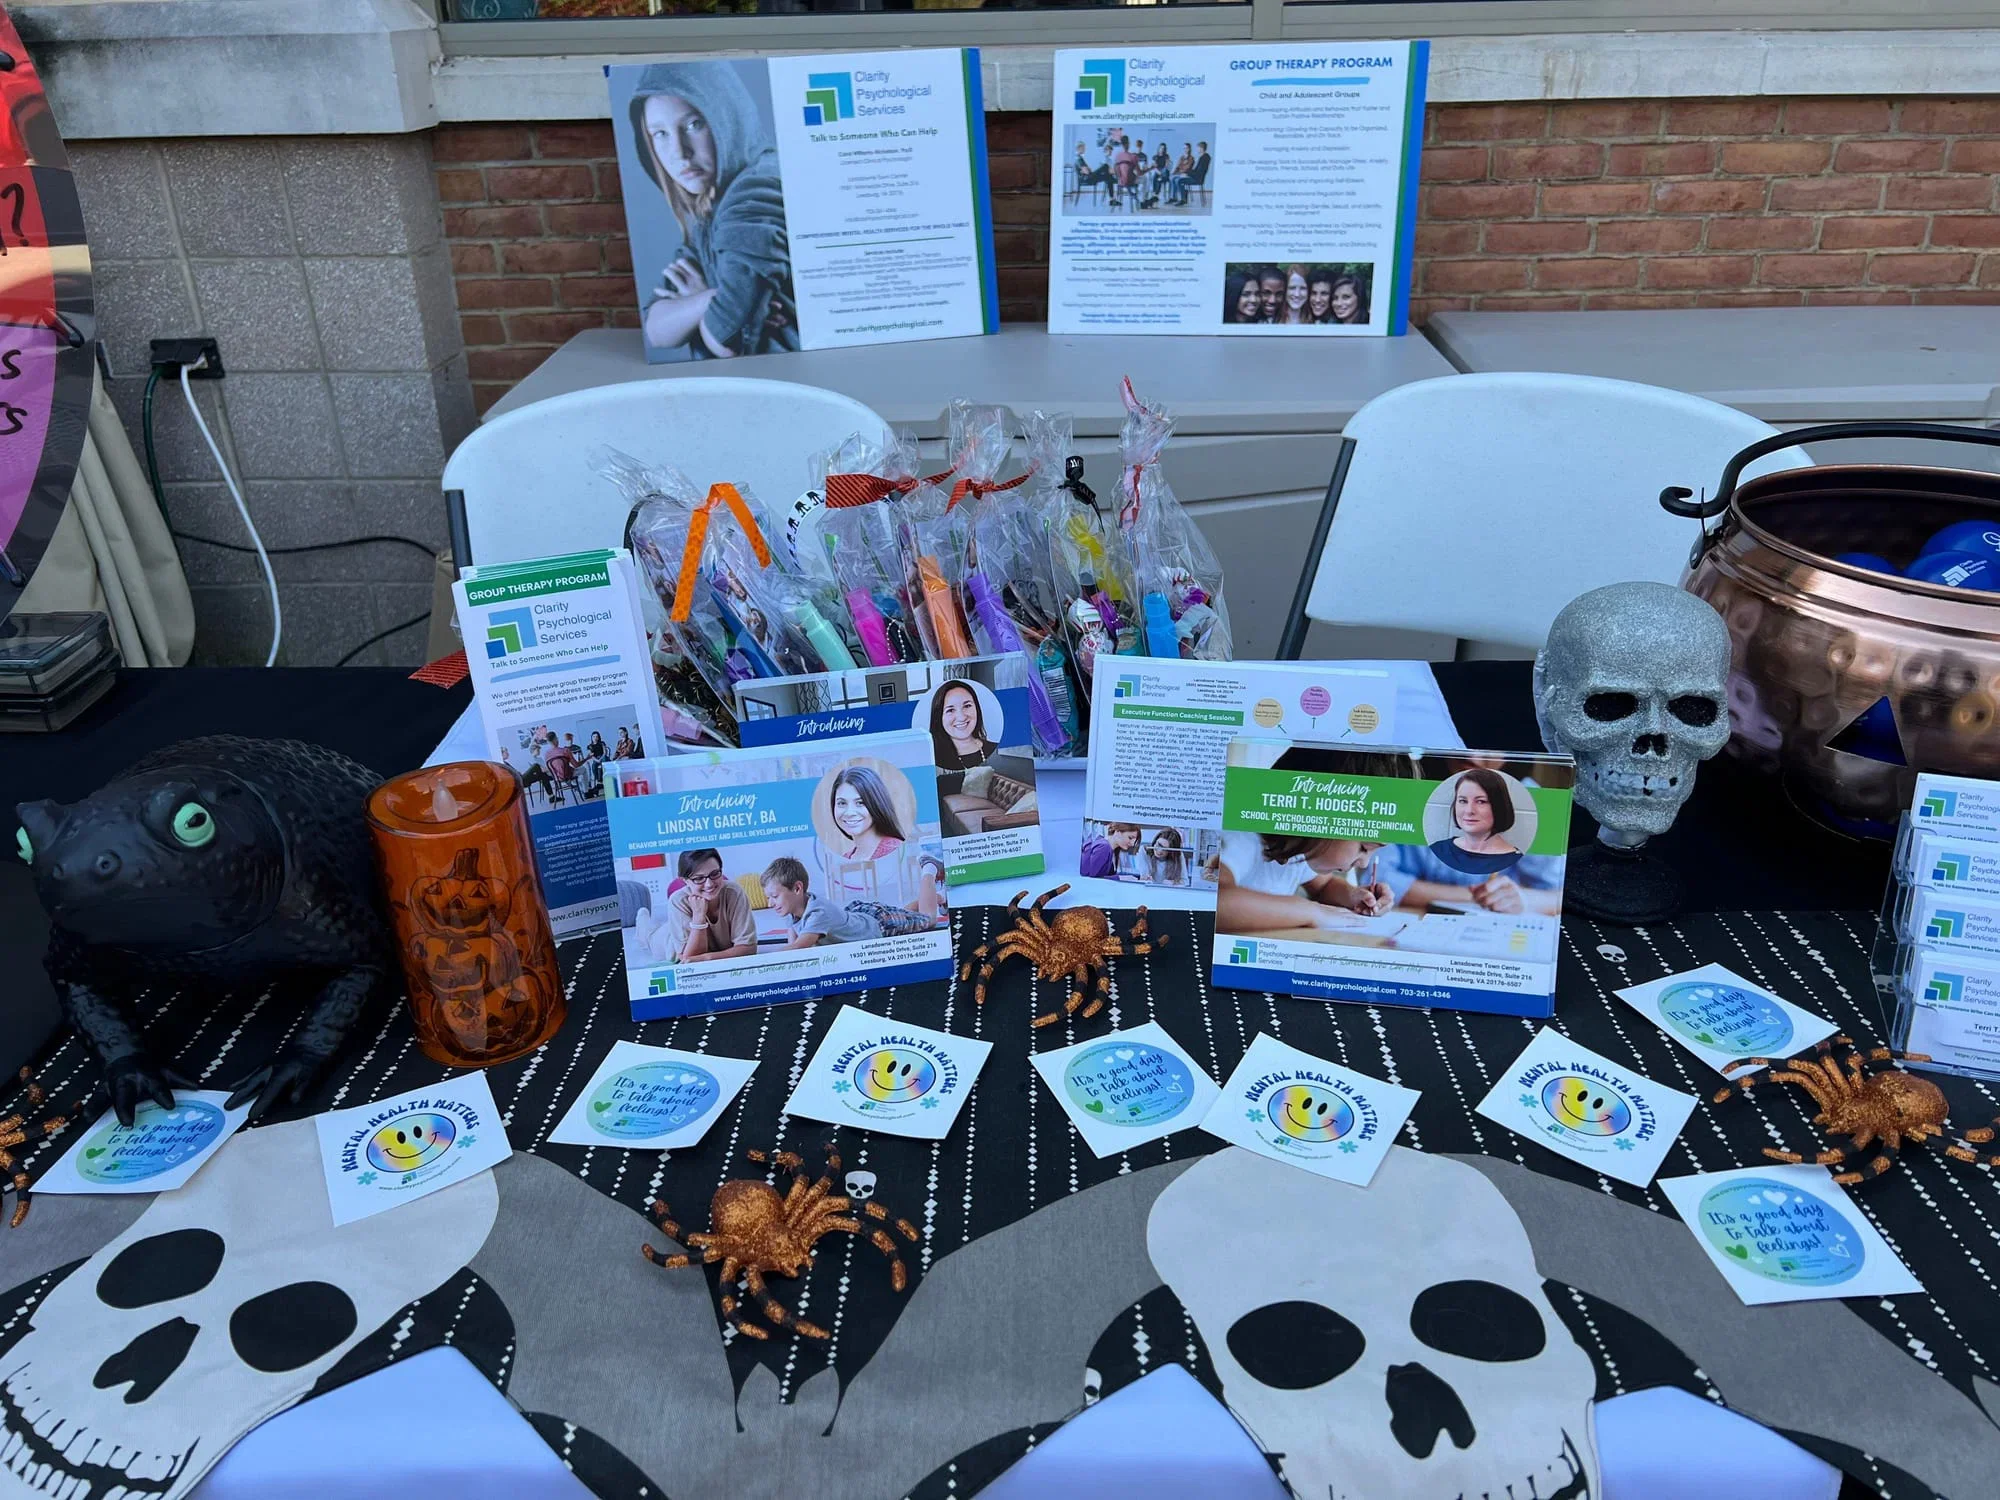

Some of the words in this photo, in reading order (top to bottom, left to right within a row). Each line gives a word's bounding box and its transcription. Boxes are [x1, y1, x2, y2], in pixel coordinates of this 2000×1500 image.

[1129, 58, 1165, 71] Clarity
[1230, 59, 1272, 71] GROUP
[1276, 59, 1328, 69] THERAPY
[1332, 57, 1392, 68] PROGRAM
[855, 71, 890, 84] Clarity
[1129, 75, 1205, 88] Psychological
[856, 85, 932, 101] Psychological
[1128, 92, 1176, 103] Services
[1335, 91, 1360, 99] Groups
[858, 104, 905, 116] Services
[469, 587, 505, 600] GROUP
[507, 580, 553, 595] THERAPY
[555, 572, 607, 587] PROGRAM
[534, 602, 569, 615] Clarity
[538, 610, 612, 629] Psychological
[540, 629, 587, 644] Services
[491, 661, 508, 669] Talk
[519, 652, 555, 663] Someone
[575, 647, 589, 655] Can
[591, 643, 608, 654] Help
[529, 682, 558, 693] extensive
[560, 680, 577, 688] group
[578, 675, 601, 685] therapy
[602, 671, 628, 681] program
[496, 697, 522, 707] covering
[523, 693, 543, 703] topics
[557, 687, 582, 696] address
[583, 682, 606, 692] specific
[502, 703, 527, 714] relevant
[536, 699, 562, 708] different
[602, 688, 623, 699] stages.
[1180, 712, 1208, 721] Coaching
[797, 717, 865, 737] Introducing
[1289, 775, 1370, 799] Introducing
[1960, 792, 1984, 802] Clarity
[677, 792, 758, 814] Introducing
[1262, 793, 1297, 809] TERRI
[1301, 794, 1311, 810] T.
[1315, 797, 1367, 815] HODGES,
[1372, 802, 1397, 816] PHD
[658, 819, 710, 835] LINDSAY
[714, 813, 757, 830] GAREY,
[761, 810, 776, 823] BA
[1241, 811, 1271, 820] SCHOOL
[1272, 814, 1329, 825] PSYCHOLOGIST,
[1332, 817, 1365, 827] TESTING
[1367, 819, 1415, 833] TECHNICIAN,
[1957, 811, 1988, 820] Services
[628, 841, 658, 850] BEHAVIOR
[659, 838, 684, 847] SUPPORT
[685, 834, 717, 845] SPECIALIST
[732, 831, 748, 839] SKILL
[749, 827, 789, 837] DEVELOPMENT
[790, 824, 809, 833] COACH
[1274, 823, 1290, 831] AND
[1292, 824, 1329, 835] PROGRAM
[1330, 827, 1379, 838] FACILITATOR
[1973, 856, 1998, 865] Clarity
[1259, 942, 1277, 950] Clarity
[1450, 960, 1482, 968] Lansdowne
[1456, 968, 1485, 976] Winmeade
[714, 983, 817, 1002] www.claritypsychological.com
[819, 974, 867, 988] 703-261-4346
[1292, 978, 1397, 995] www.claritypsychological.com
[1400, 988, 1451, 999] 703-261-4346
[1967, 976, 1992, 986] Clarity
[1667, 1011, 1689, 1021] It's
[1692, 1007, 1700, 1015] a
[1699, 998, 1722, 1013] good
[1720, 990, 1745, 1004] day
[1964, 996, 1997, 1006] Services
[1686, 1021, 1700, 1030] to
[1702, 1012, 1724, 1025] talk
[1724, 1000, 1755, 1018] about
[1713, 1015, 1760, 1036] feelings!
[1974, 1023, 1991, 1031] Terri
[832, 1040, 877, 1074] MENTAL
[881, 1036, 936, 1053] HEALTH
[933, 1051, 958, 1095] MATTERS
[1071, 1075, 1093, 1088] It's
[1097, 1071, 1106, 1079] a
[1109, 1062, 1138, 1077] good
[1139, 1053, 1163, 1066] day
[613, 1076, 634, 1088] It's
[651, 1084, 682, 1095] good
[685, 1087, 710, 1097] day
[1085, 1086, 1099, 1098] to
[1101, 1078, 1129, 1092] talk
[1132, 1064, 1168, 1082] about
[1110, 1078, 1164, 1104] feelings!
[612, 1090, 625, 1100] to
[628, 1091, 657, 1102] talk
[659, 1096, 698, 1105] about
[1245, 1071, 1292, 1102] MENTAL
[1295, 1070, 1355, 1095] HEALTH
[1352, 1094, 1378, 1141] MATTERS
[1518, 1061, 1567, 1088] MENTAL
[1571, 1062, 1631, 1093] HEALTH
[1629, 1094, 1656, 1142] MATTERS
[619, 1103, 678, 1115] feelings!
[138, 1124, 149, 1132] a
[150, 1122, 184, 1132] good
[187, 1122, 215, 1133] day
[342, 1128, 369, 1172] MENTAL
[368, 1099, 429, 1127] HEALTH
[433, 1099, 480, 1130] MATTERS
[107, 1134, 122, 1145] to
[125, 1133, 155, 1144] talk
[158, 1133, 198, 1144] about
[112, 1145, 174, 1157] feelings!
[1707, 1211, 1735, 1226] It's
[1739, 1213, 1751, 1222] a
[1755, 1205, 1791, 1223] good
[1793, 1202, 1825, 1216] day
[1725, 1227, 1744, 1240] to
[1744, 1223, 1781, 1238] talk
[1784, 1219, 1830, 1233] about
[1756, 1234, 1824, 1254] feelings!
